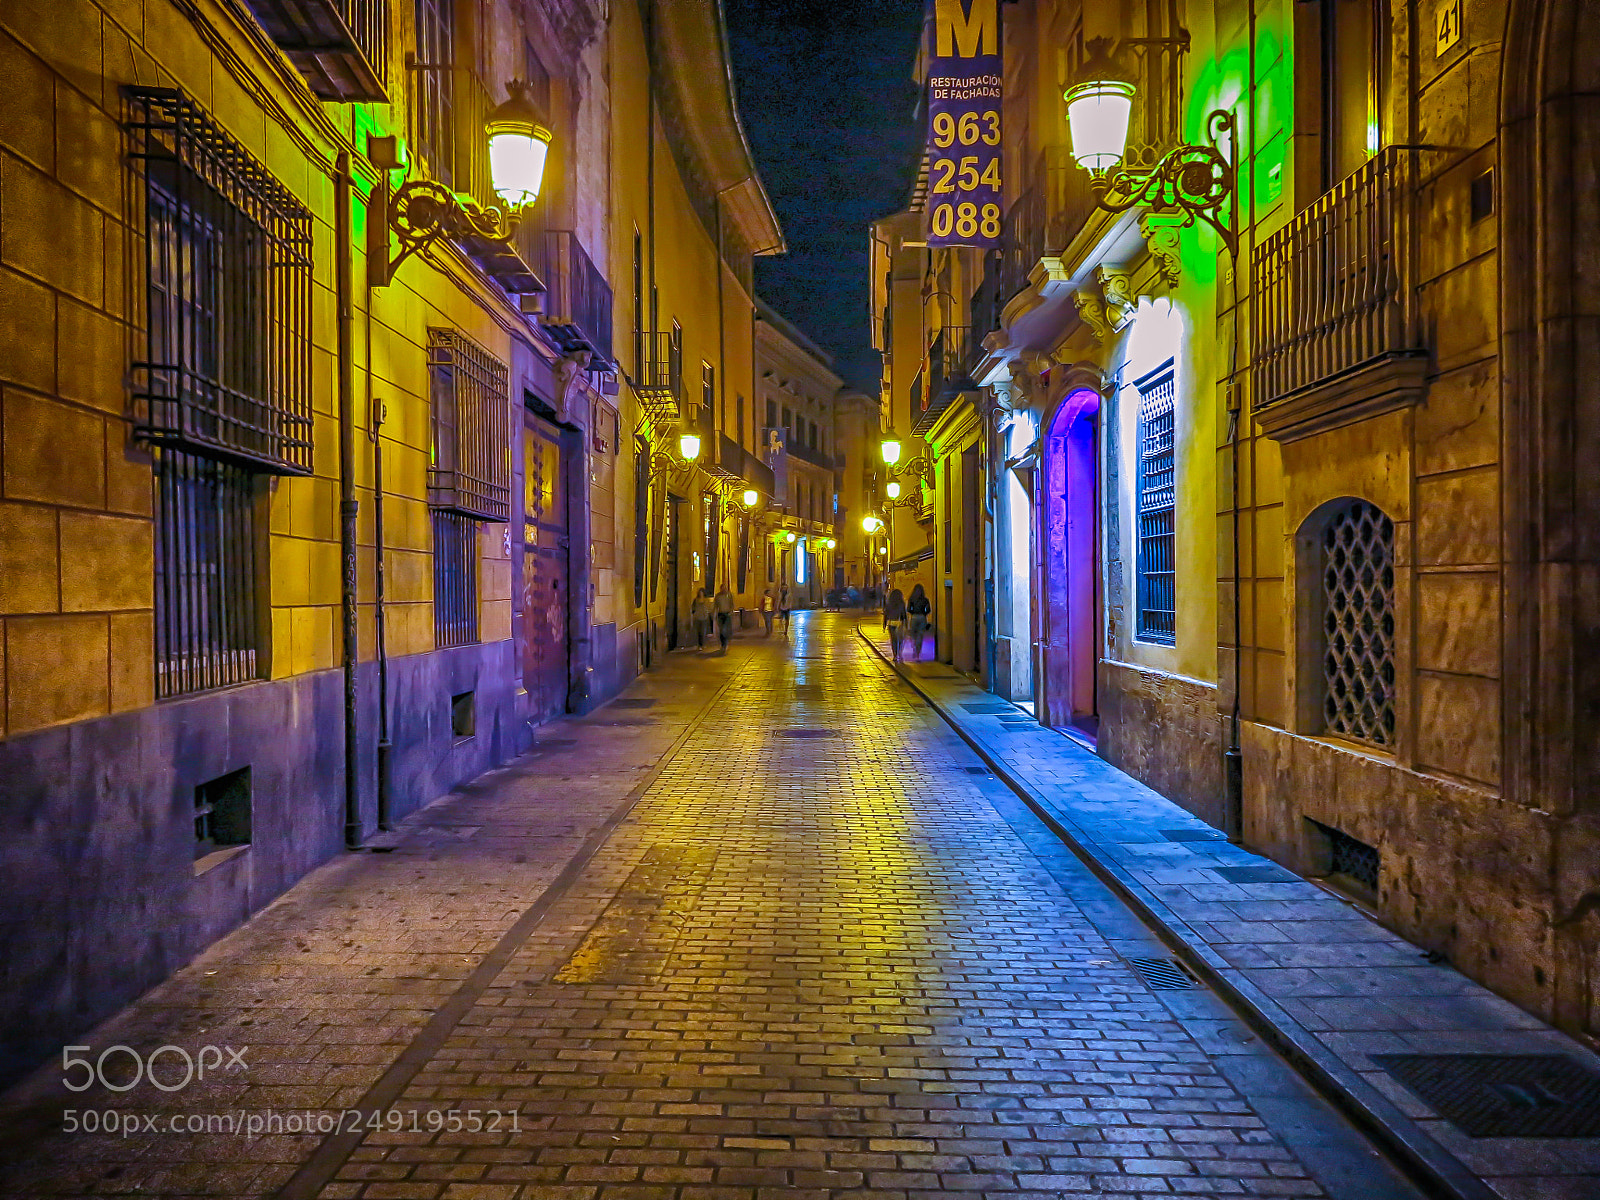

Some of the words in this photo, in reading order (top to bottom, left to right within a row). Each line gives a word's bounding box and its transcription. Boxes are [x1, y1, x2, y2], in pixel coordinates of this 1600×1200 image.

[935, 0, 998, 58] M
[1439, 0, 1458, 44] 41
[934, 89, 949, 99] DE
[950, 86, 1001, 100] FACHADAS
[933, 111, 1000, 148] 963
[933, 156, 1001, 194] 254
[932, 202, 1000, 238] 088
